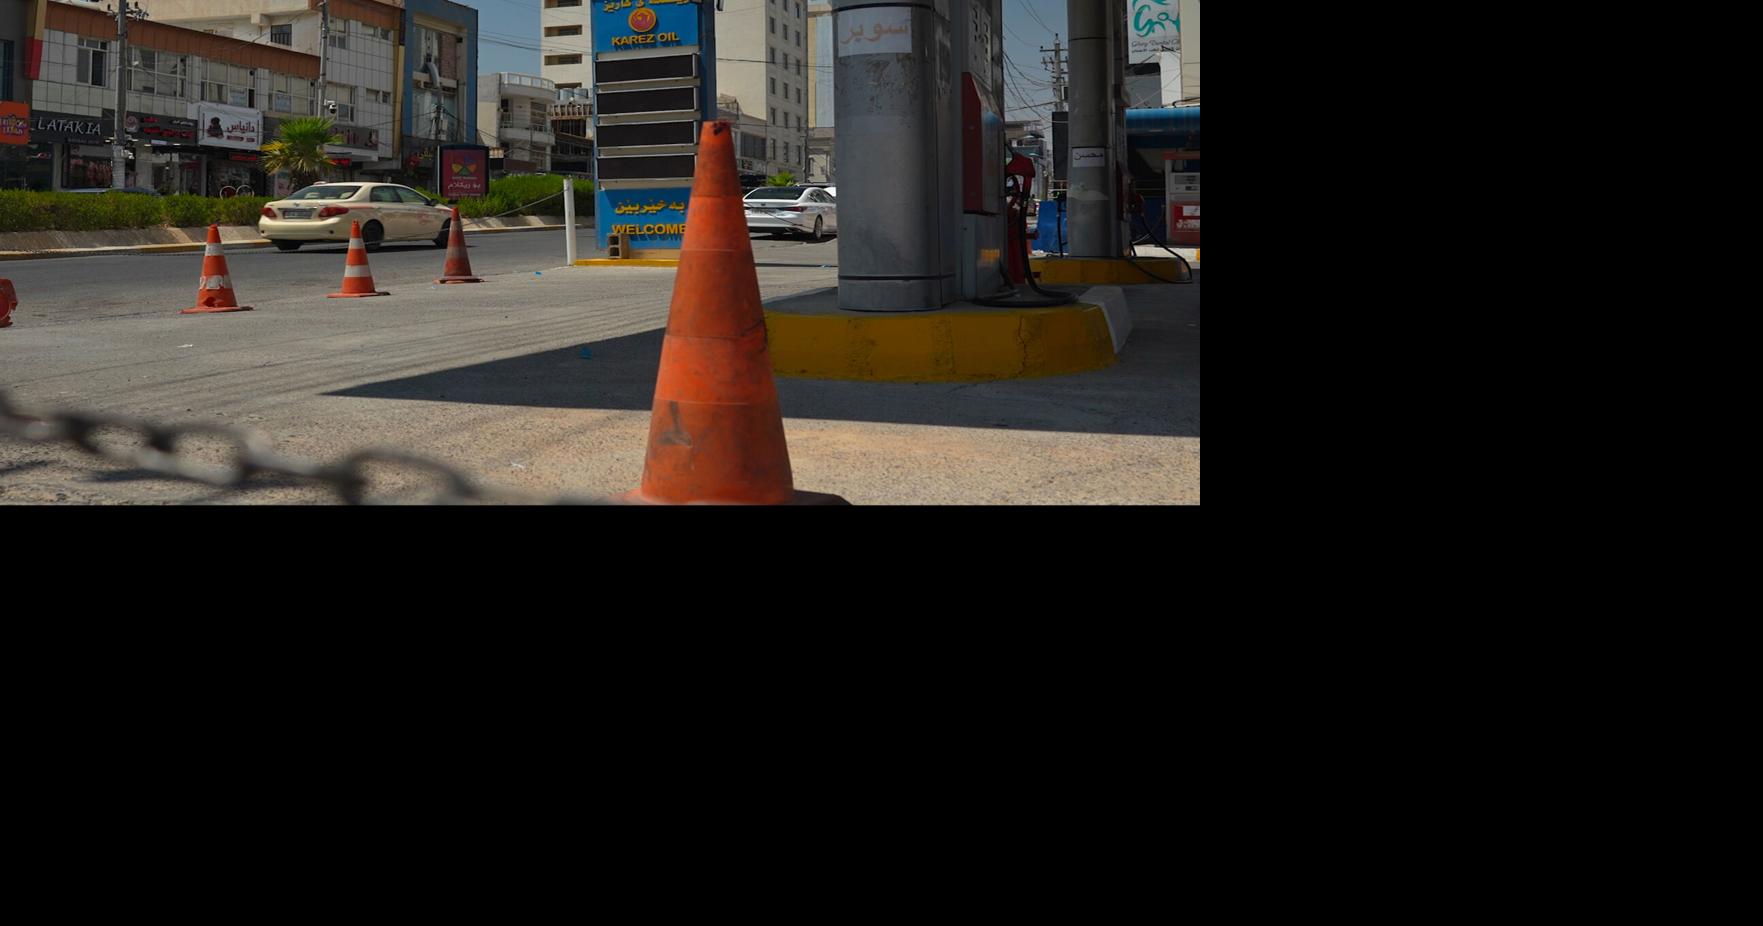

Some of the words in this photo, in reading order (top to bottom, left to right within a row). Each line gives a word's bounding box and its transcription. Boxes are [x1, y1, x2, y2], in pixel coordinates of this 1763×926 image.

[612, 34, 655, 45] KAREZ
[657, 31, 680, 42] OIL
[37, 116, 101, 136] LATAKIA
[612, 224, 686, 234] WELCOME
